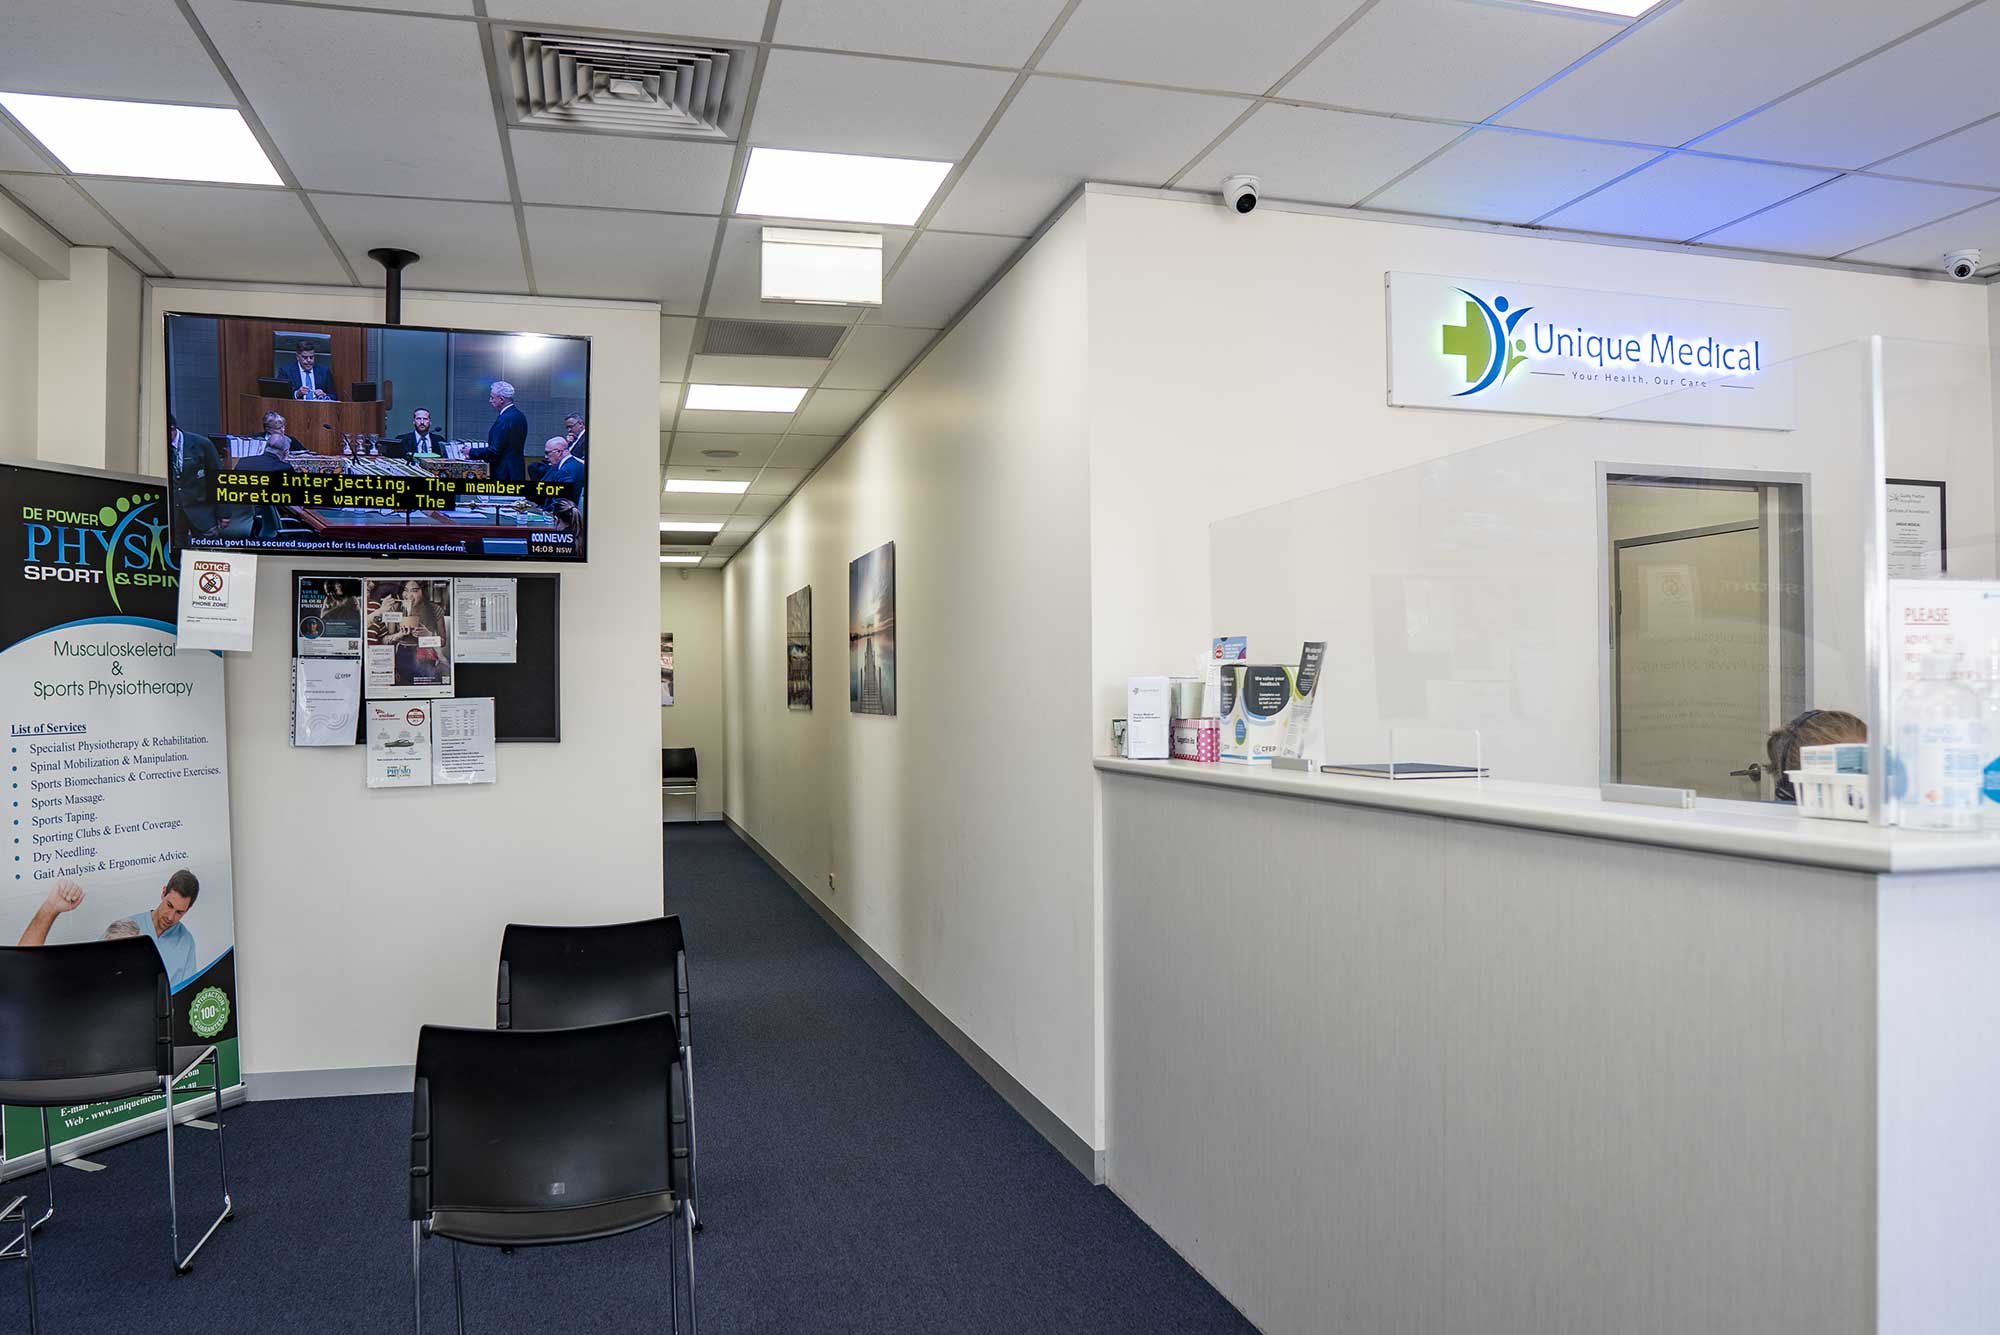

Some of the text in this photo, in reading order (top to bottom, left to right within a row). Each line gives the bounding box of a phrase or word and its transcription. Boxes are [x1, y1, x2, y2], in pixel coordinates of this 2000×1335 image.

[1534, 322, 1760, 371] Unique Medical
[1572, 371, 1598, 381] Your
[1654, 376, 1675, 386] Our
[1680, 377, 1708, 387] Care
[217, 473, 565, 496] cease interjecting. The member for
[216, 487, 446, 508] Moreton is warned. The
[23, 506, 99, 526] DE POWER
[191, 537, 464, 552] Federal govt has secured support for its industrial relations reform
[544, 533, 574, 543] NEWS
[531, 545, 554, 553] 14:08
[24, 565, 103, 584] SPORT
[195, 563, 229, 572] NOTICE
[114, 572, 132, 585] &
[1904, 607, 1950, 622] PLEASE
[54, 640, 176, 657] Musculoskeletal
[111, 660, 124, 676] &
[34, 679, 194, 700] Sports Physiotherapy
[11, 722, 87, 736] List of Services
[29, 734, 209, 756] Specialist Physiotherapy & Rehabilitation.
[30, 752, 189, 775] Spinal Mobilization & Manipulation.
[31, 766, 222, 793] Sports Biomechanics & Corrective Exercises.
[31, 793, 105, 811] Sports Massage.
[32, 811, 98, 829] Sports Taping.
[32, 818, 184, 846] Sporting Clubs & Event Coverage.
[33, 846, 98, 865] Dry Needling.
[33, 850, 189, 881] Gait Analysis & Ergonomic Advice.
[64, 1115, 84, 1128] Web
